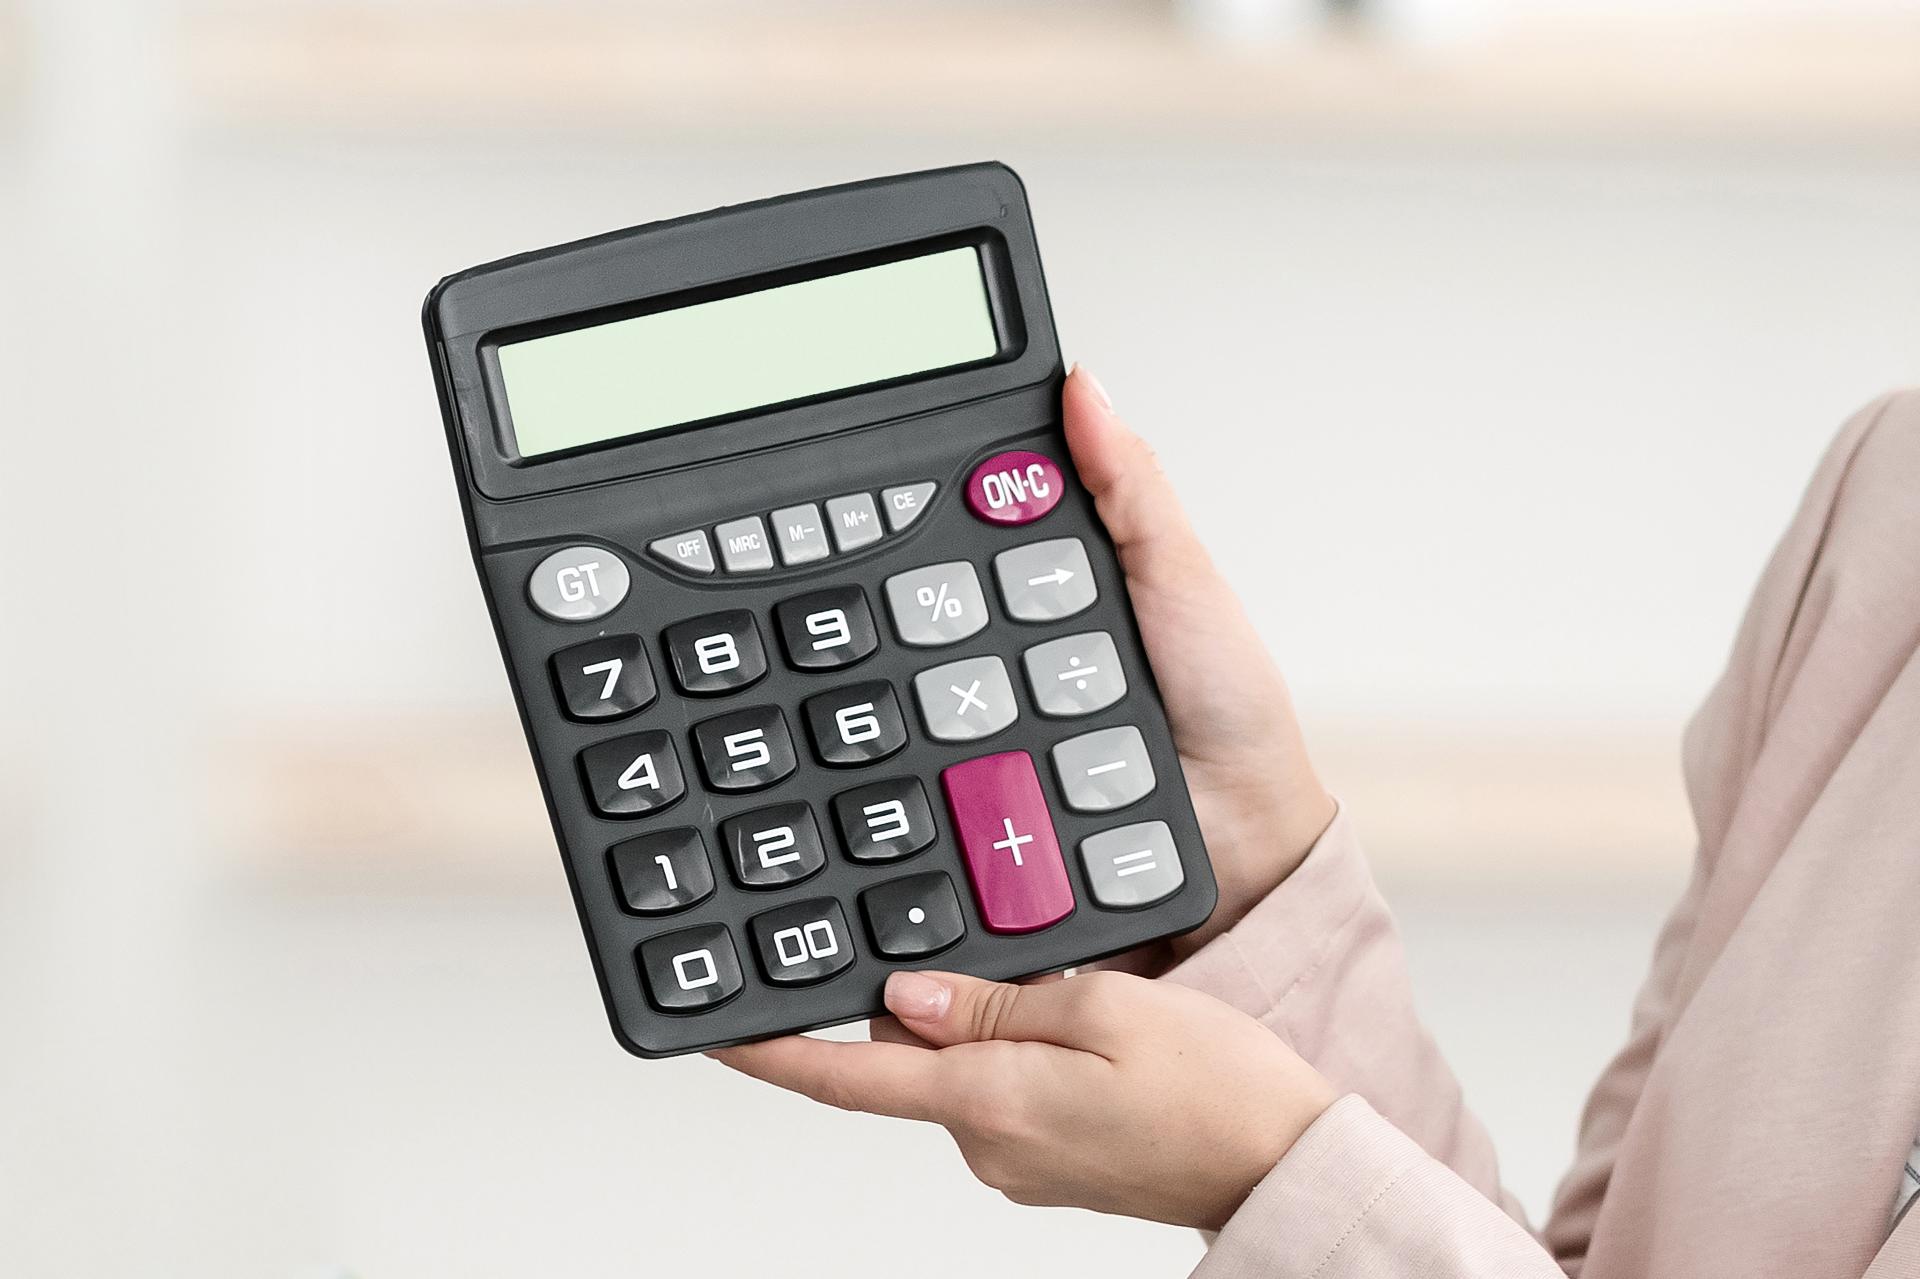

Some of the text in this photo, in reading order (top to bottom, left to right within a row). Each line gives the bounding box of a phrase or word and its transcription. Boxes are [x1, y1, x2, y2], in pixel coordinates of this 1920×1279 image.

[842, 510, 869, 528] M+
[893, 491, 916, 510] CE
[676, 539, 701, 559] OFF
[728, 533, 761, 554] MRC
[556, 562, 600, 602] GT
[916, 582, 962, 623] %
[805, 608, 851, 651] 9
[694, 633, 740, 675] 8
[582, 658, 623, 700] 7
[835, 702, 881, 745] 6
[723, 728, 771, 772] 5
[617, 753, 660, 790] 4
[863, 800, 910, 843] 3
[992, 817, 1034, 867] +
[752, 826, 801, 869] 2
[654, 854, 678, 890] 1
[773, 919, 839, 967] 00
[672, 949, 719, 991] 0
